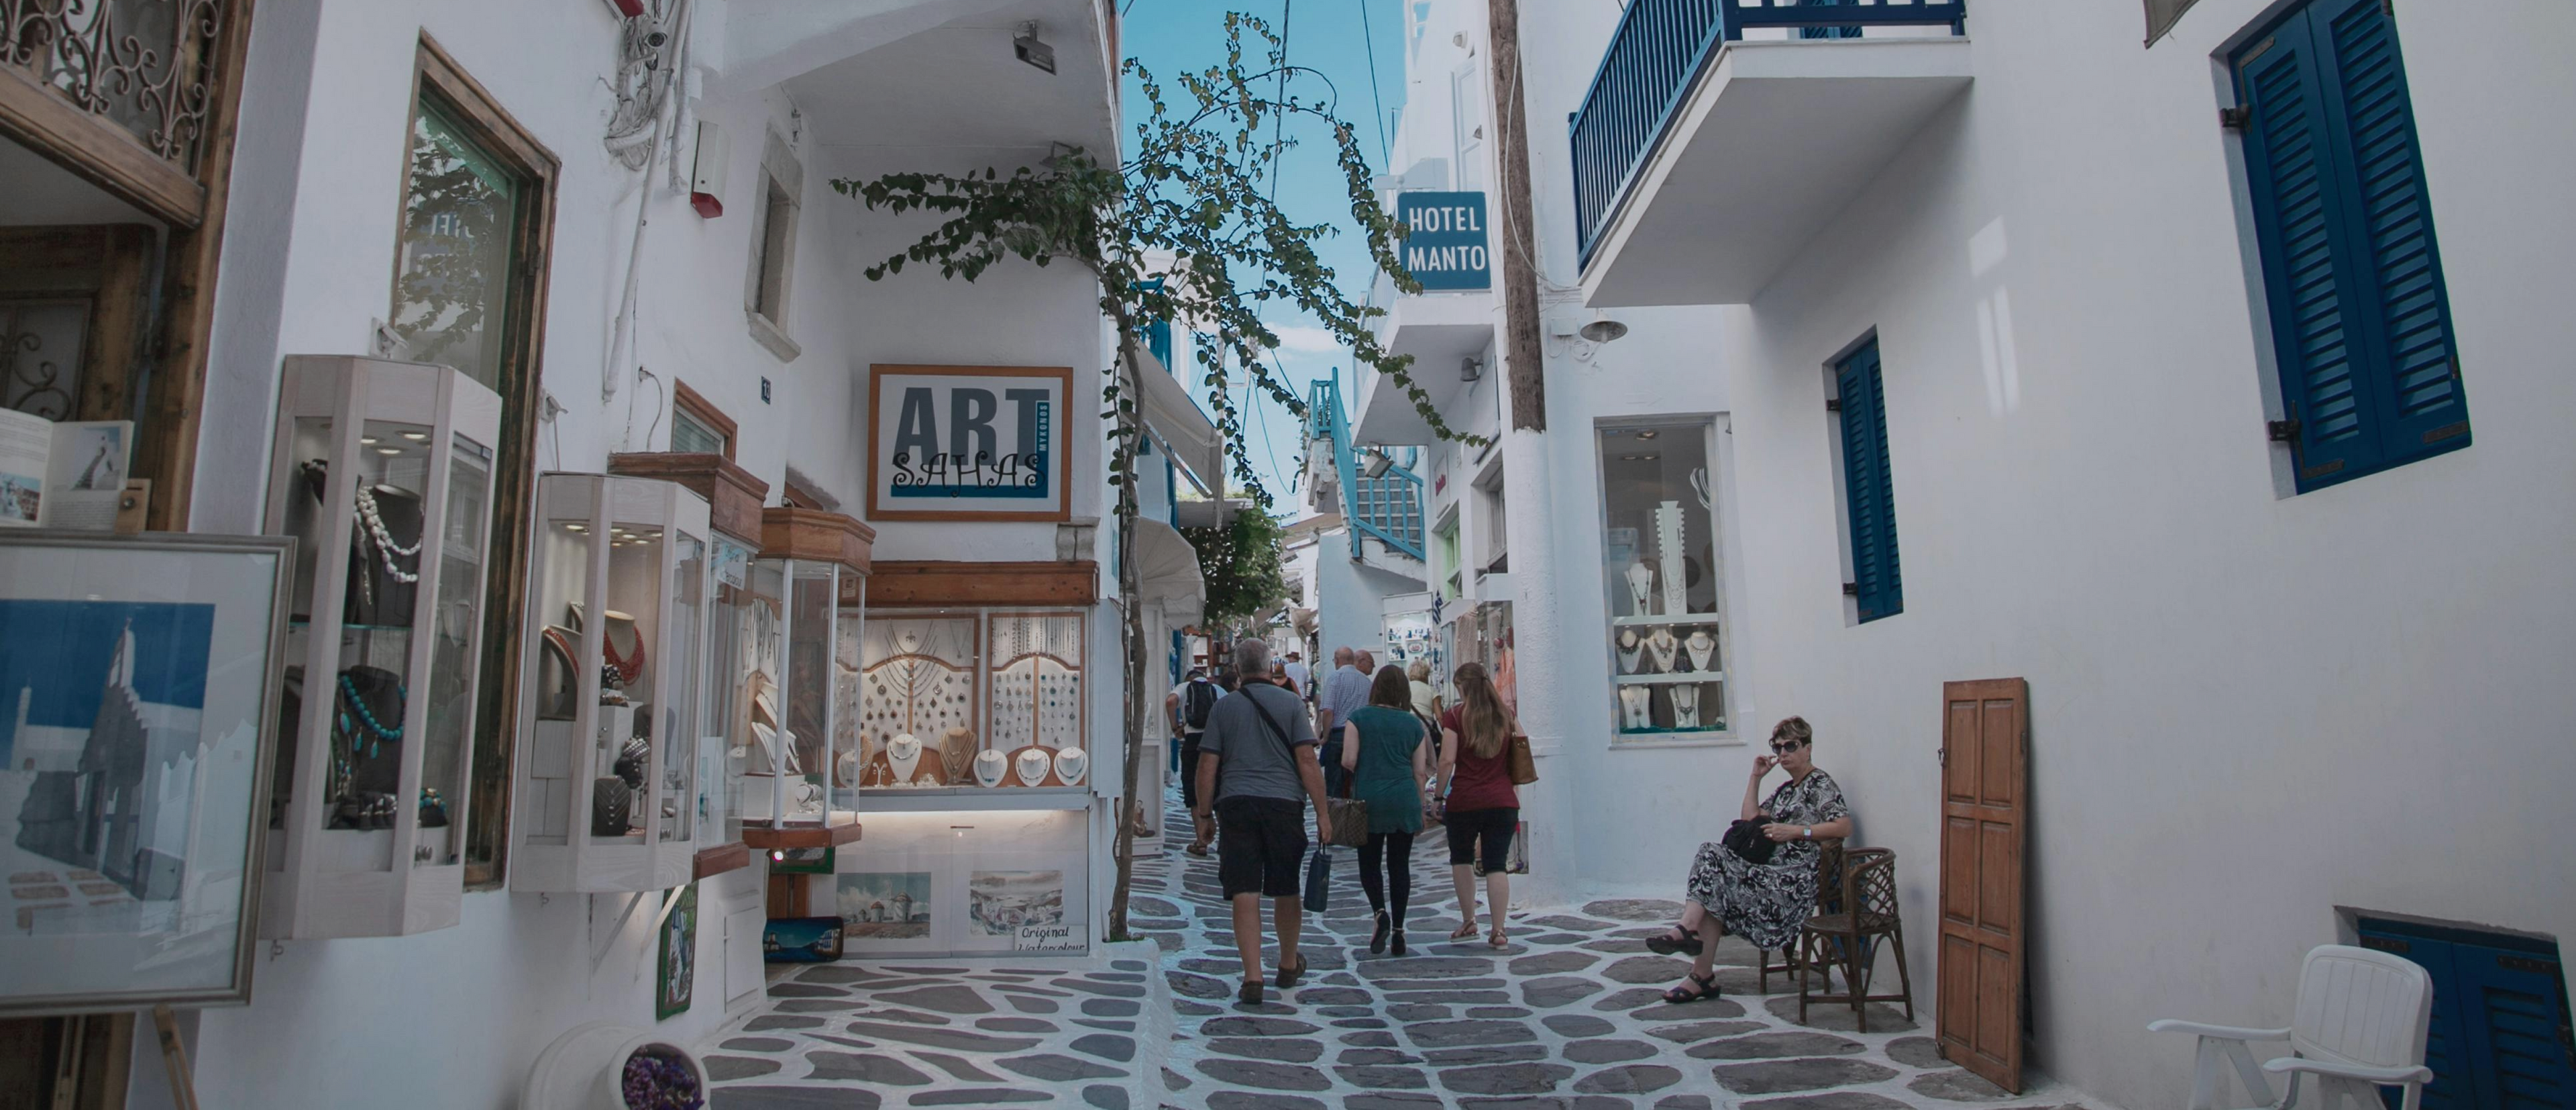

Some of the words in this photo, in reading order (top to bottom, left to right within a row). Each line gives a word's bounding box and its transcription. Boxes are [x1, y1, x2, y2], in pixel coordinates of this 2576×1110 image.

[1409, 207, 1480, 232] HOTEL
[1408, 246, 1485, 271] MANTO
[892, 387, 1049, 466] ART
[1039, 405, 1048, 451] MYKONOS
[893, 450, 1045, 497] SAHAS
[1022, 926, 1069, 942] Original
